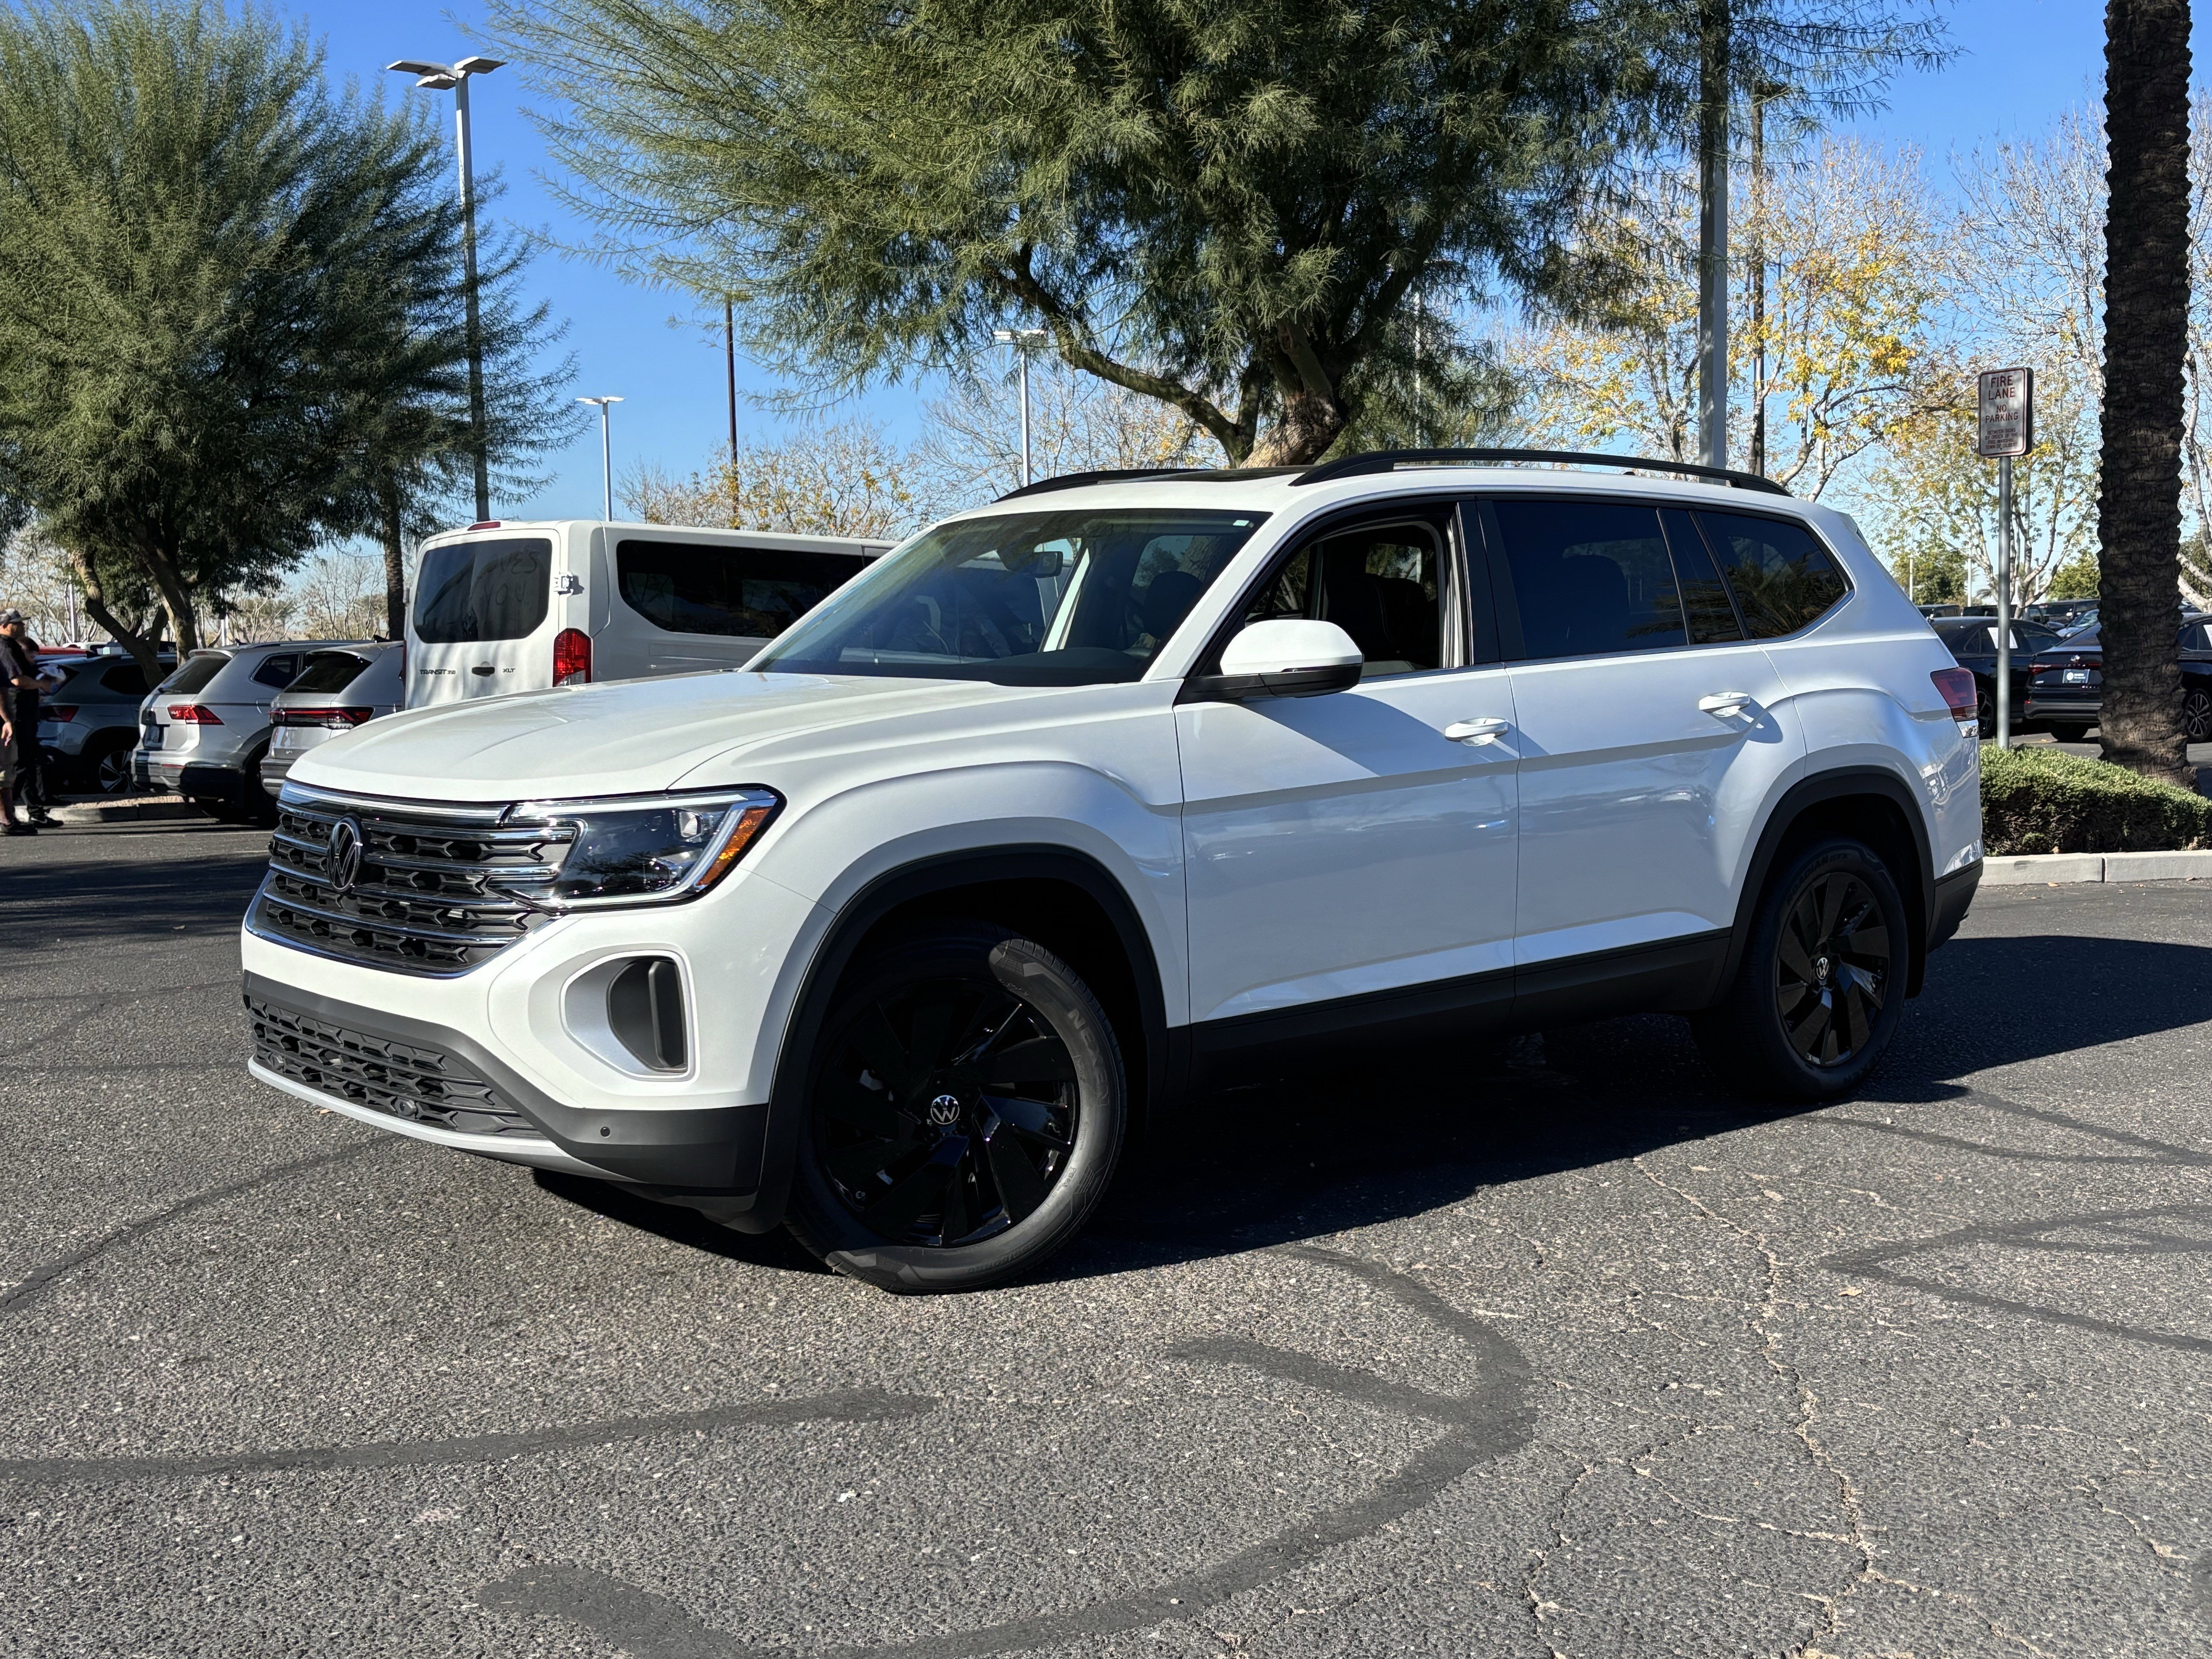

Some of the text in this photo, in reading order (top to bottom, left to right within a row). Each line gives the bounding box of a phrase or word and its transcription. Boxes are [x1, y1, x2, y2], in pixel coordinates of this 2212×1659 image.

[1990, 375, 2013, 388] FIRE
[1989, 387, 2015, 400] LANE
[1996, 405, 2007, 413] NO
[1985, 412, 2018, 423] PARKING
[1816, 957, 1829, 979] VW
[1068, 1008, 1109, 1106] NEXEN
[931, 1095, 960, 1125] VW
